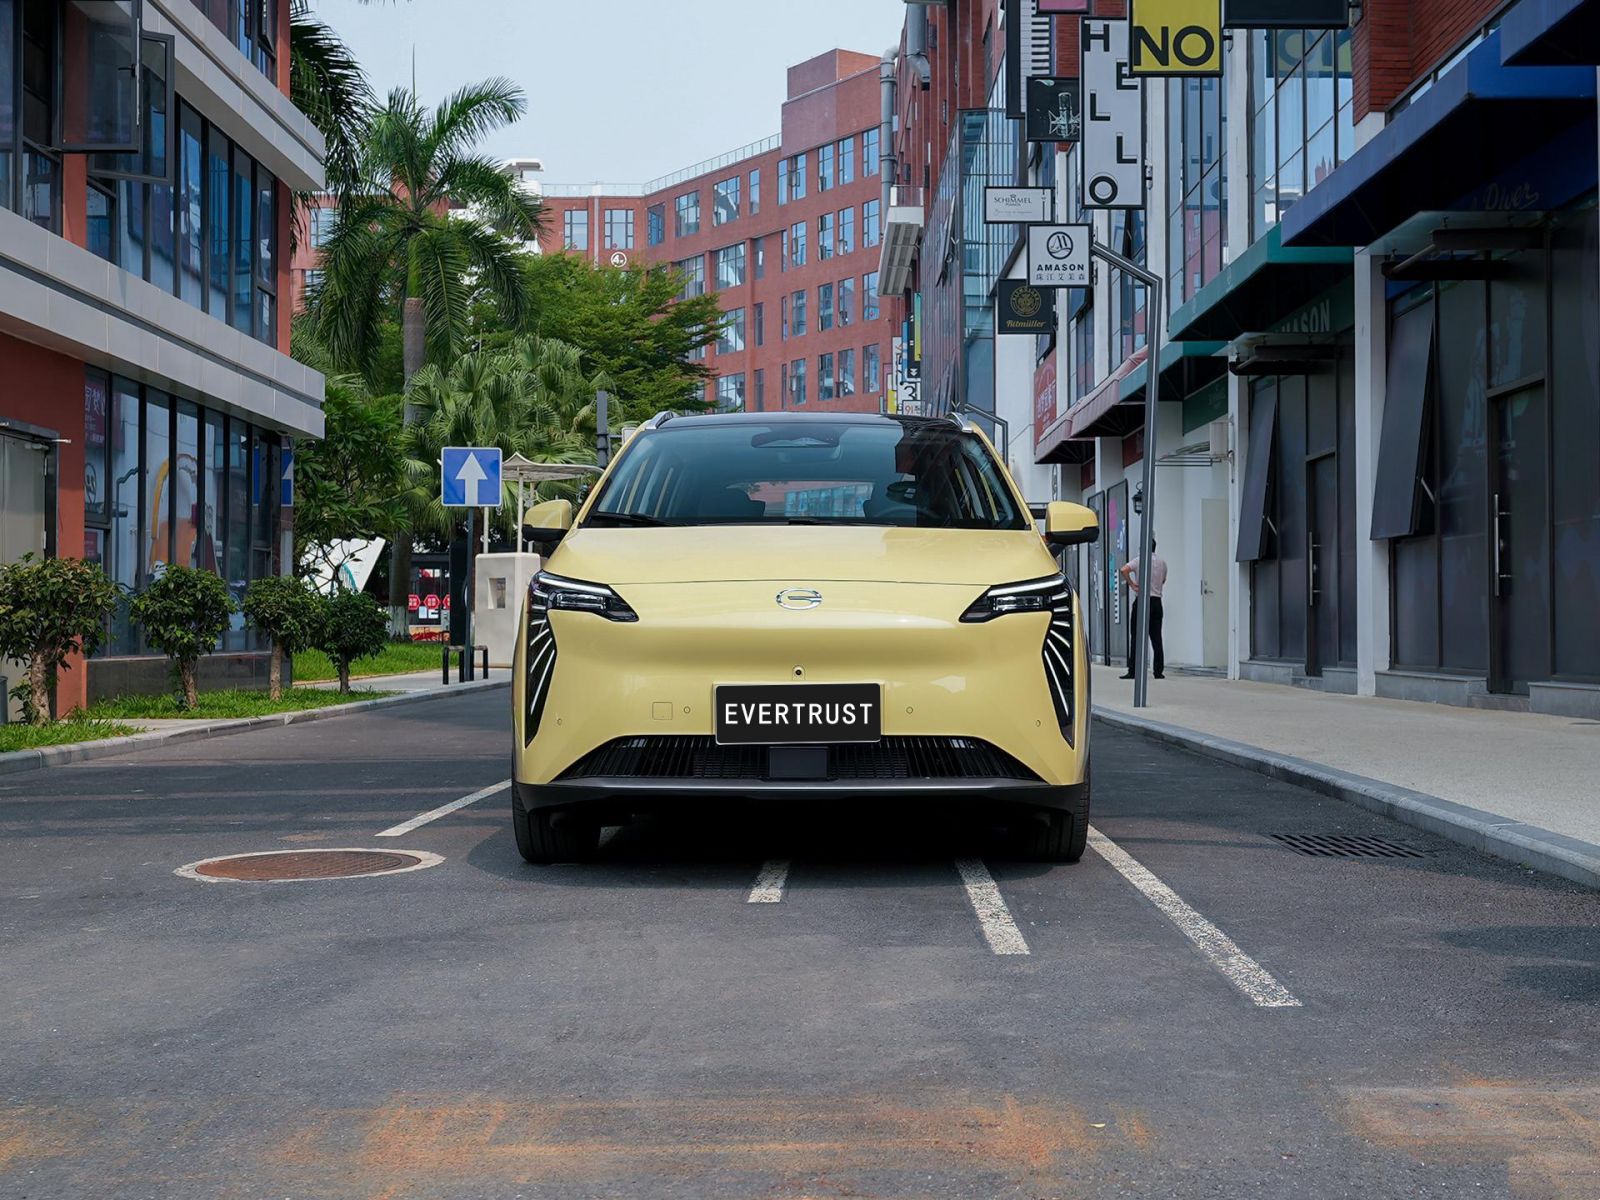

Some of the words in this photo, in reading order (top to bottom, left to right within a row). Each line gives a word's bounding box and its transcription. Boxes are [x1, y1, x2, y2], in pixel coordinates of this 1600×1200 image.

[1133, 26, 1214, 66] NO
[1037, 263, 1085, 271] AMASON
[725, 703, 873, 724] EVERTRUST
